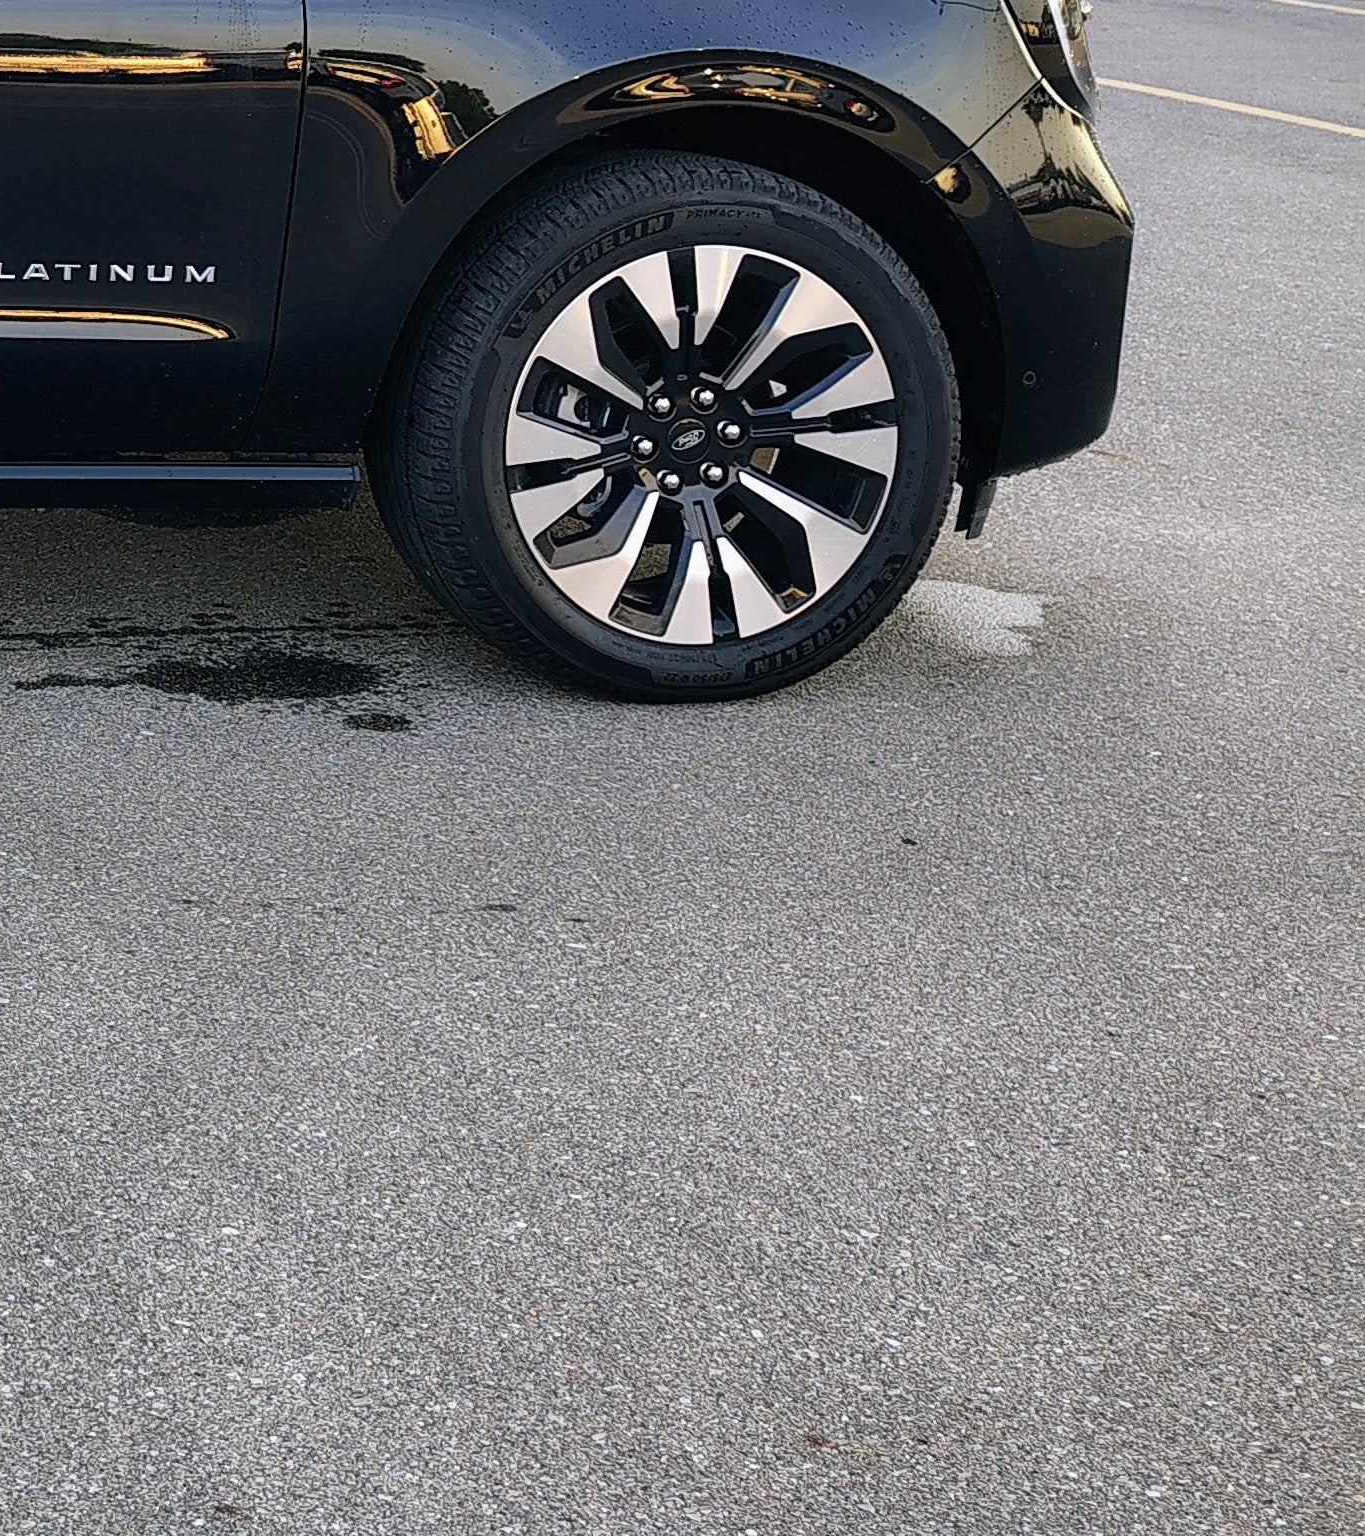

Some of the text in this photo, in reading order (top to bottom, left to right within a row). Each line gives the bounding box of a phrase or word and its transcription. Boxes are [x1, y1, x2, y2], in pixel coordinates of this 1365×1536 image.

[686, 207, 744, 220] PRIMACY
[535, 215, 666, 305] MICHELIN
[754, 587, 876, 675] MICHELIN
